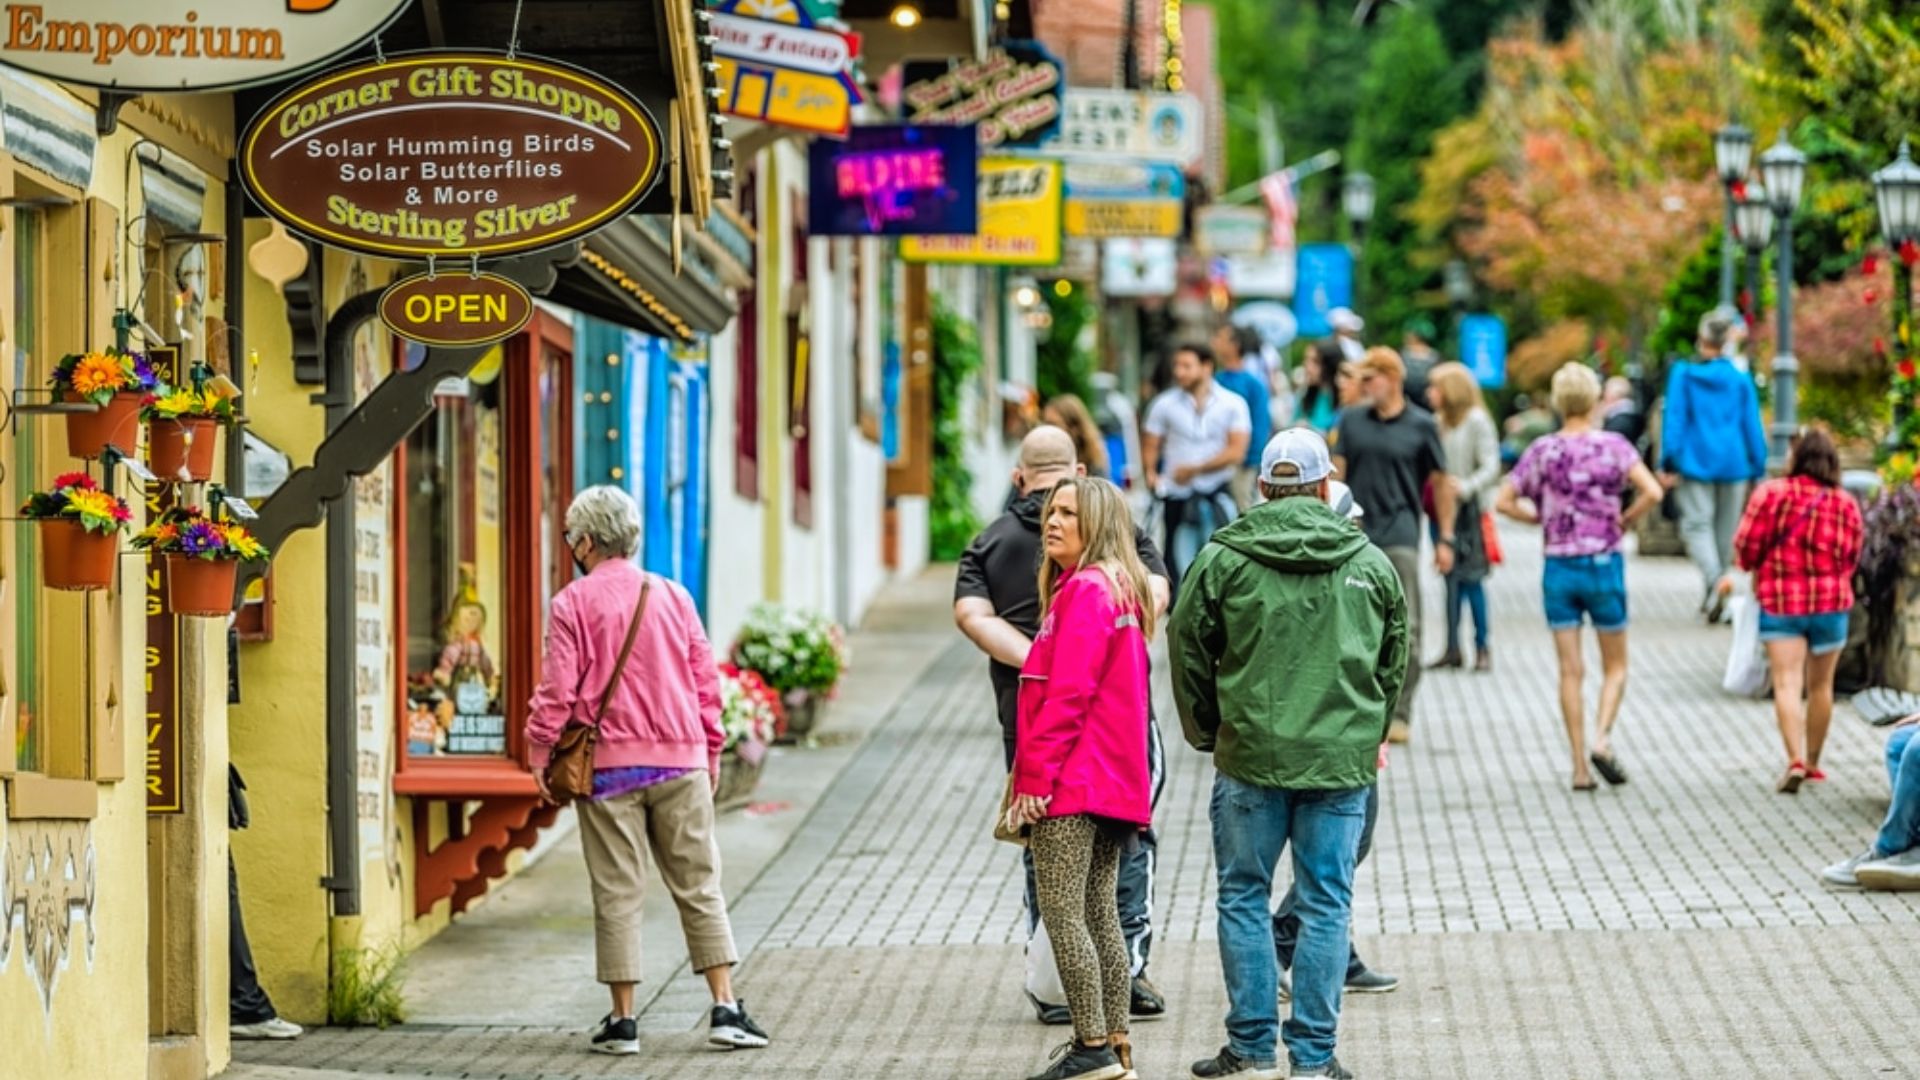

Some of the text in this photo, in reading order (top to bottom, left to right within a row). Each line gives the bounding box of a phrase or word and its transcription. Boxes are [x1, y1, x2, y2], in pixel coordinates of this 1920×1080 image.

[4, 4, 285, 64] Emporium
[279, 67, 621, 139] Corner Gift Shoppe
[306, 134, 596, 158] Solar Humming Birds
[339, 160, 563, 182] Solar Butterflies
[404, 185, 499, 205] & More
[327, 194, 578, 247] Sterling Silver
[404, 294, 508, 324] OPEN
